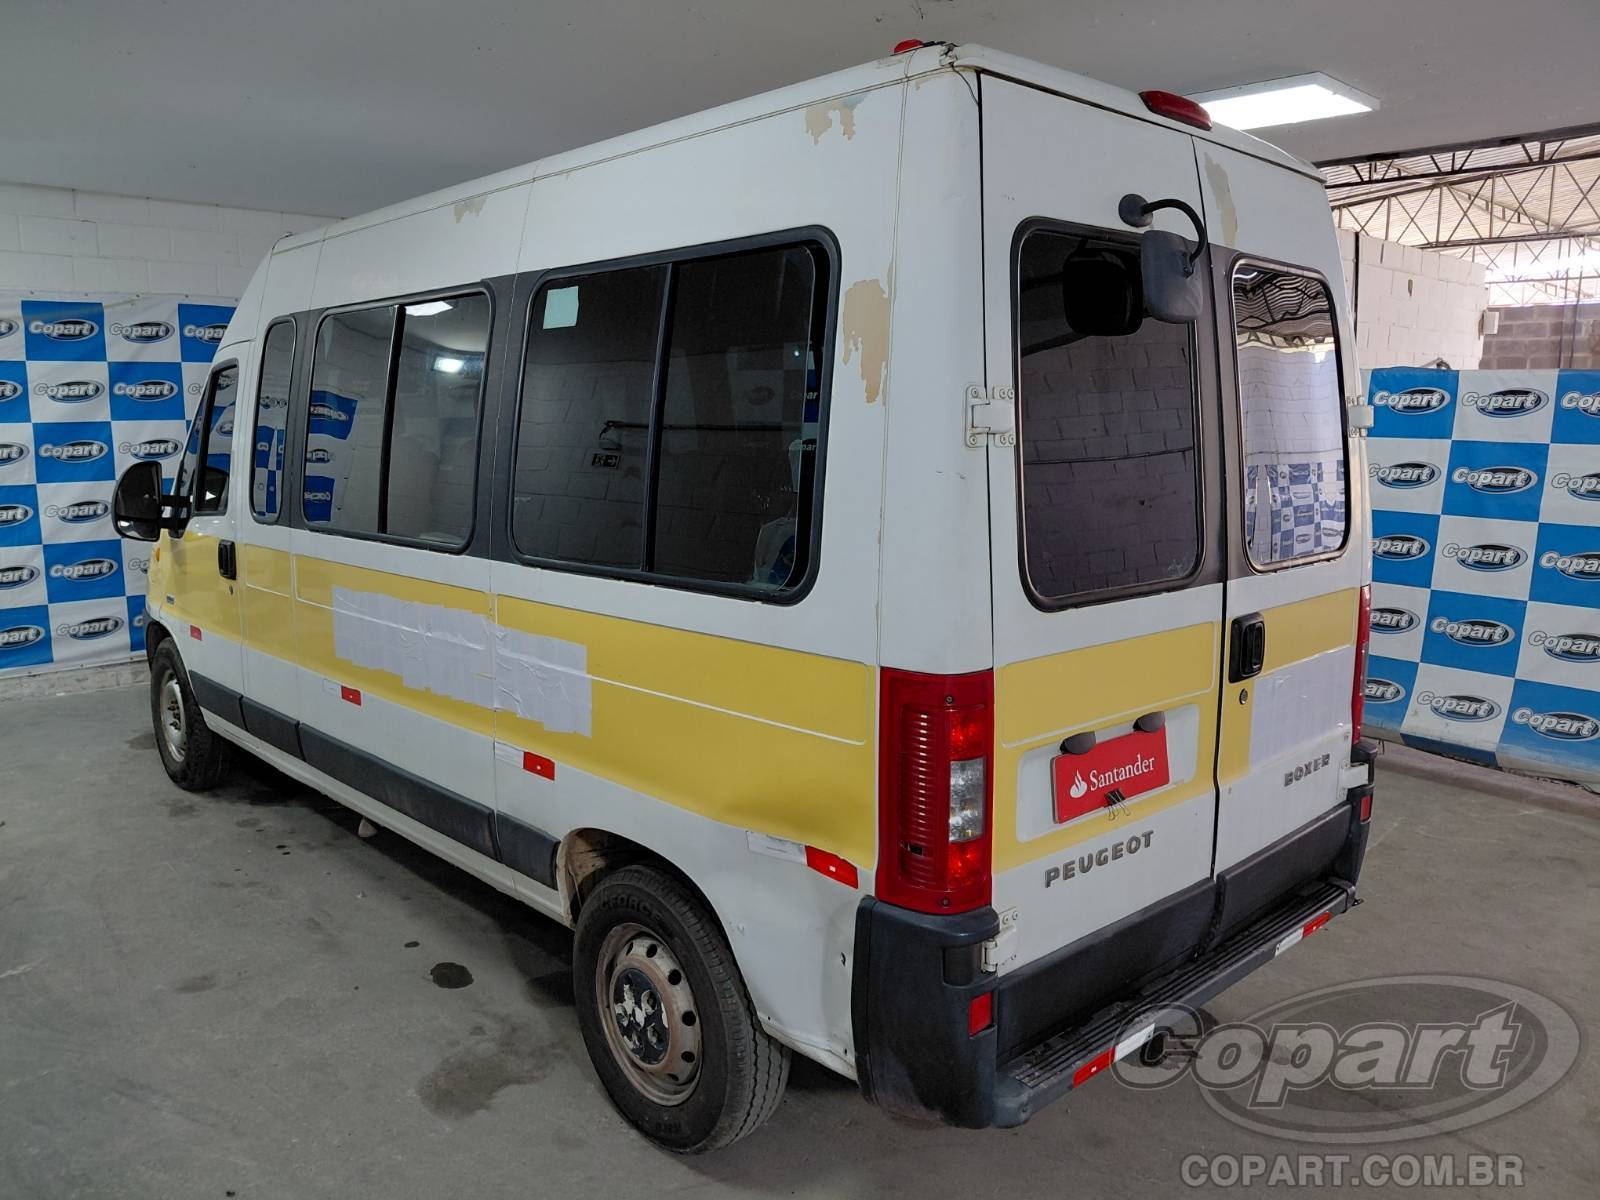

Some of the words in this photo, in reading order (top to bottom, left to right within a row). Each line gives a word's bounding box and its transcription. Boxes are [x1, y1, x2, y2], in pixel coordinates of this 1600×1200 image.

[29, 321, 92, 337] Copart
[110, 323, 168, 338] Copart
[184, 325, 224, 339] Copa
[33, 383, 97, 398] Copart
[113, 382, 172, 397] Copart
[1373, 390, 1443, 410] Copart
[1462, 391, 1536, 413] Copart
[1561, 391, 1600, 414] Cop
[39, 443, 101, 459] Copart
[119, 441, 176, 456] Copart
[1368, 462, 1432, 483] Copart
[1452, 467, 1527, 489] Copart
[1552, 473, 1600, 494] Cop
[45, 503, 105, 519] Copart
[1372, 539, 1423, 555] opart
[1442, 543, 1516, 565] Copart
[50, 561, 111, 578] Copart
[1540, 551, 1600, 575] Copa
[0, 569, 32, 582] art
[56, 619, 116, 636] Copart
[1370, 611, 1409, 629] part
[1431, 617, 1508, 643] Copart
[1364, 682, 1398, 700] art
[1417, 691, 1490, 719] Copart
[1512, 707, 1595, 737] Copart
[1089, 755, 1155, 792] Santander
[1283, 753, 1331, 787] BOXER
[1044, 829, 1155, 888] PEUGEOT
